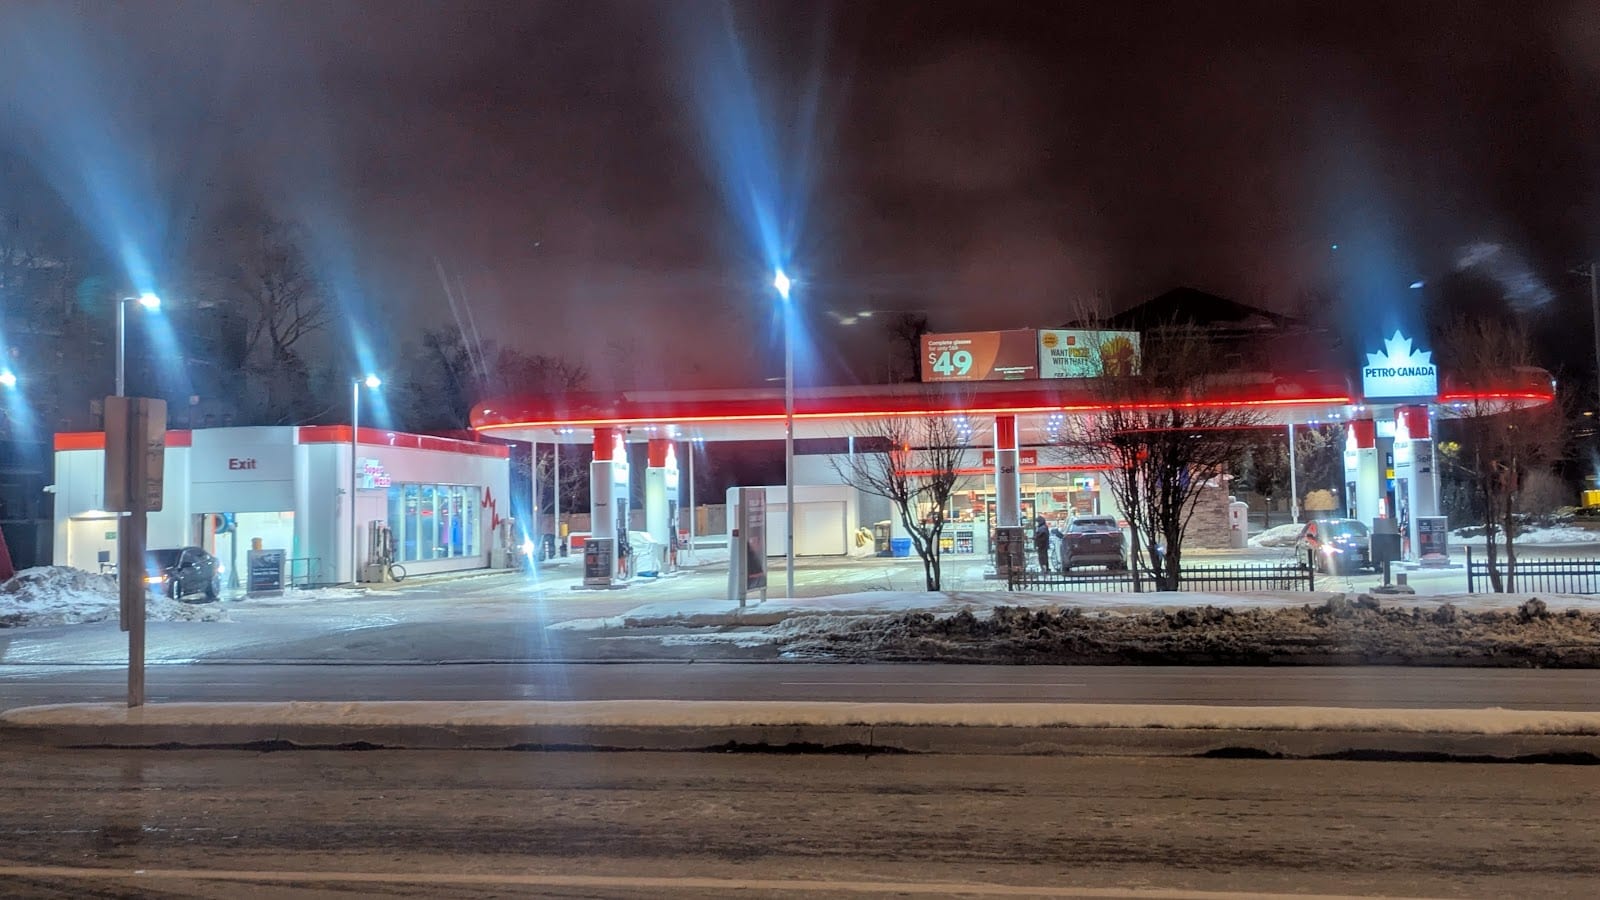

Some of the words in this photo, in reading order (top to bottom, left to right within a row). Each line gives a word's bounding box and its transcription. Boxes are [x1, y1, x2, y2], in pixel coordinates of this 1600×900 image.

[1050, 348, 1068, 357] WANT
[928, 350, 973, 376] $49
[1052, 358, 1069, 366] WITH
[229, 458, 257, 470] Exit
[364, 464, 383, 474] Super
